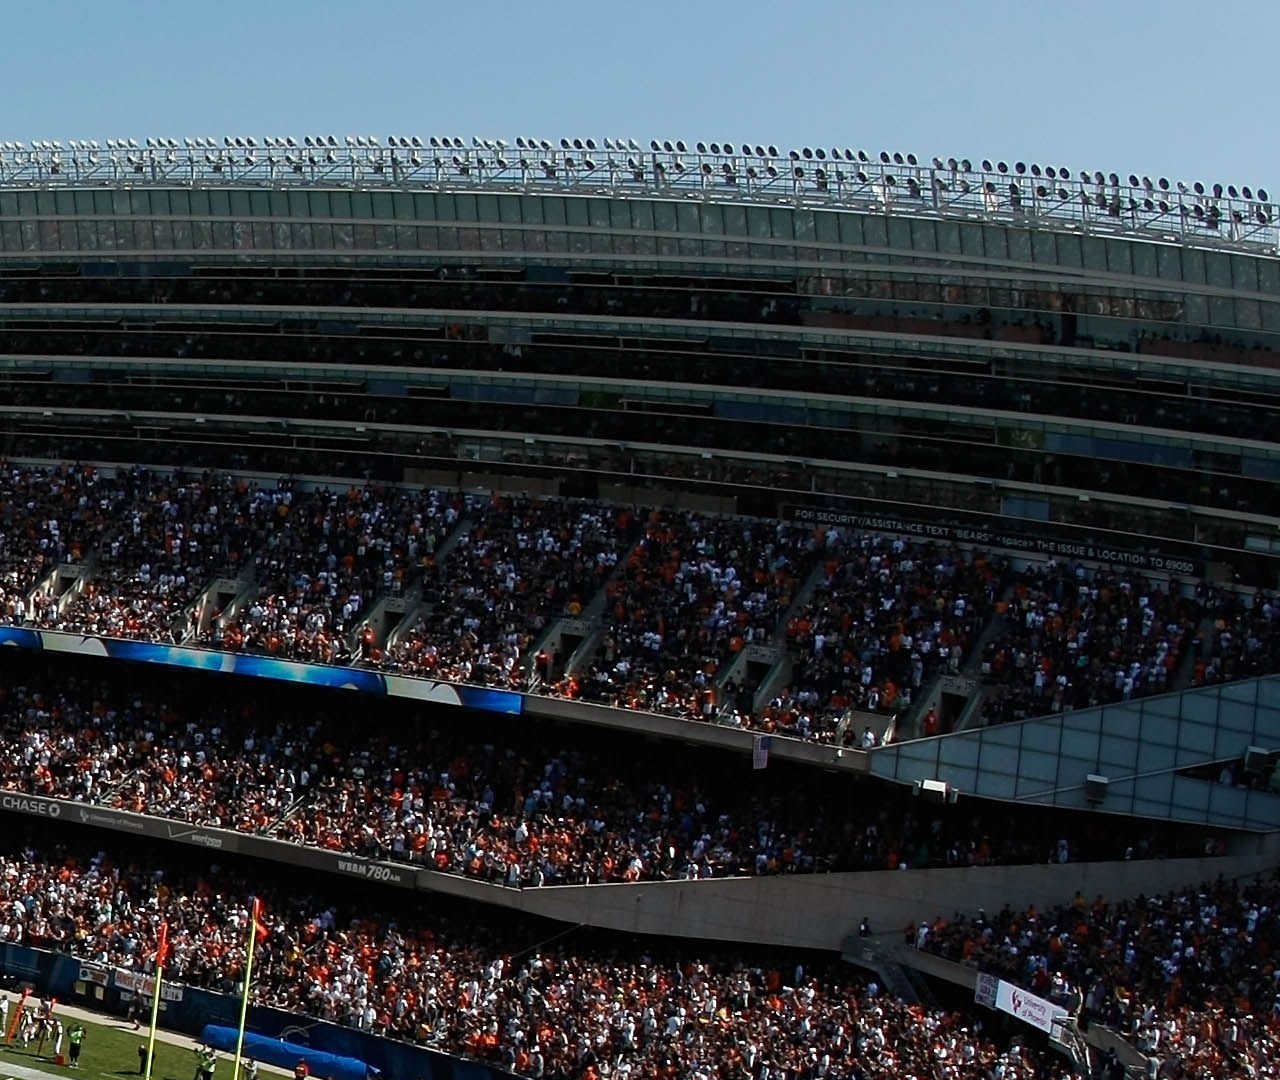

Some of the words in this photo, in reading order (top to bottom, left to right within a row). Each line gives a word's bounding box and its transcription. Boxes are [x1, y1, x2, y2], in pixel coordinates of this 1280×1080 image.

[795, 508, 815, 521] FOR
[925, 525, 949, 537] TEXT
[1037, 540, 1056, 552] THE
[1057, 543, 1085, 556] ISSUE
[1097, 549, 1146, 565] LOCATION
[1148, 557, 1165, 567] TO
[2, 796, 47, 815] CHASE
[338, 860, 367, 875] WBBM
[366, 864, 391, 881] 780
